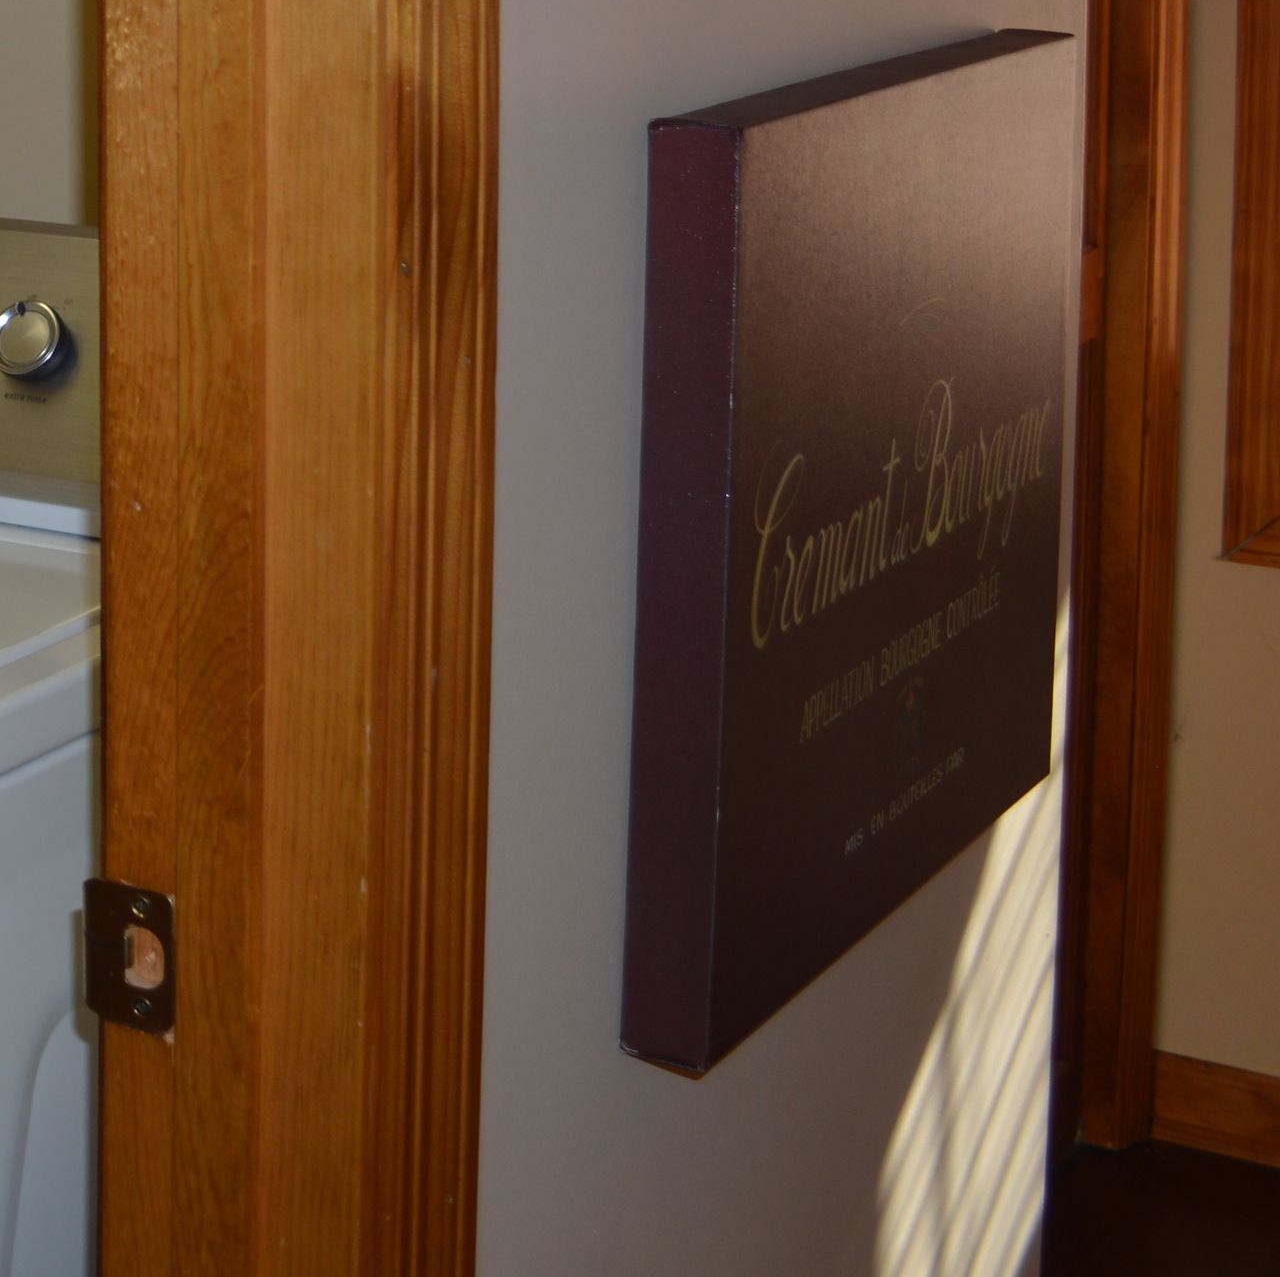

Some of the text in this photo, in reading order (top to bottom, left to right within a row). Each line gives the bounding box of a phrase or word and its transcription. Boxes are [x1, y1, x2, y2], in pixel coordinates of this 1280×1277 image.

[911, 377, 1050, 561] Bourgogne
[799, 566, 1000, 746] APPELLATION BOURGOGNE CONTRÔLÉE
